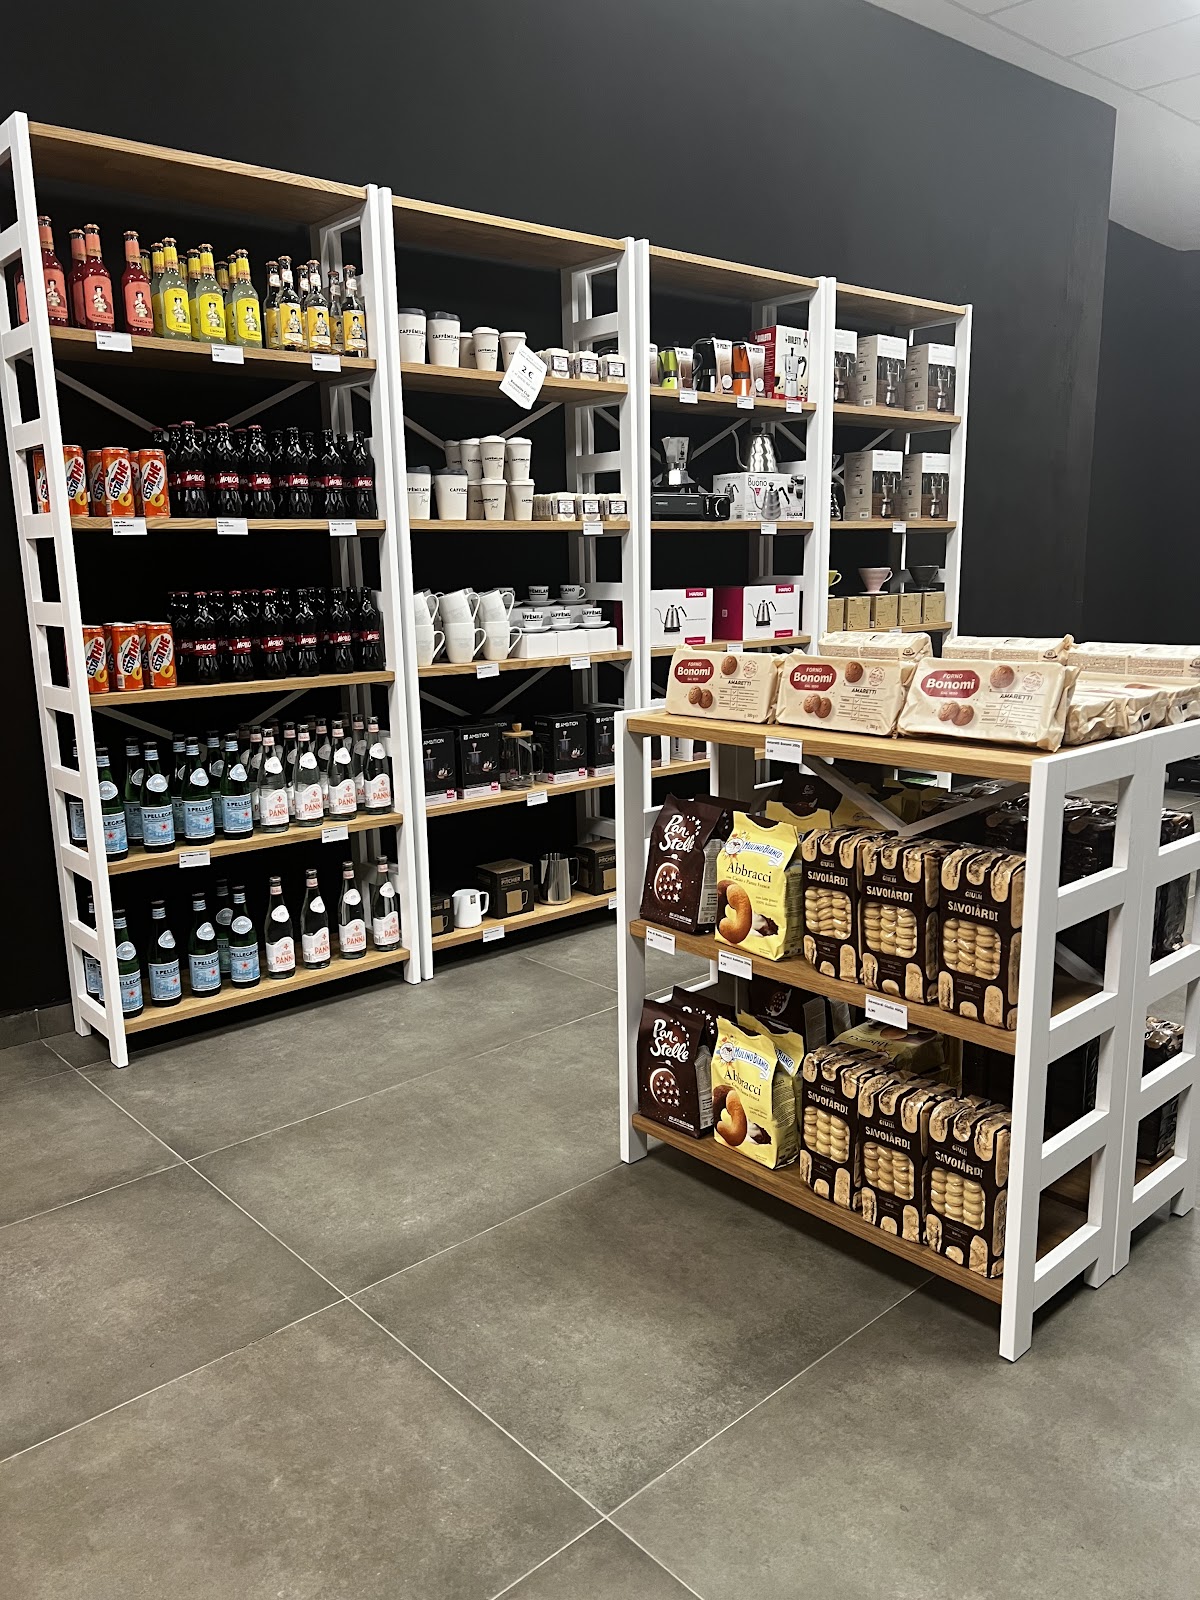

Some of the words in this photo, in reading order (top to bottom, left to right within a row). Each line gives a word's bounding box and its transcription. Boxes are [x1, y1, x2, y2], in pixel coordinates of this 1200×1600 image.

[521, 364, 527, 374] 2
[747, 476, 768, 487] Buono
[677, 666, 711, 676] Bonomi
[793, 671, 833, 683] Bonomi
[926, 678, 976, 690] Bonomi
[851, 687, 877, 695] AMARETTI
[999, 693, 1033, 701] AMARETTI
[468, 732, 490, 740] AMBITION
[423, 738, 445, 746] AMBITION
[664, 814, 687, 839] Pan
[726, 861, 772, 883] Abbracci
[500, 876, 521, 887] PITCHER
[653, 1018, 674, 1043] Pan
[650, 1036, 690, 1063] Stelle
[723, 1069, 762, 1097] Abbracci
